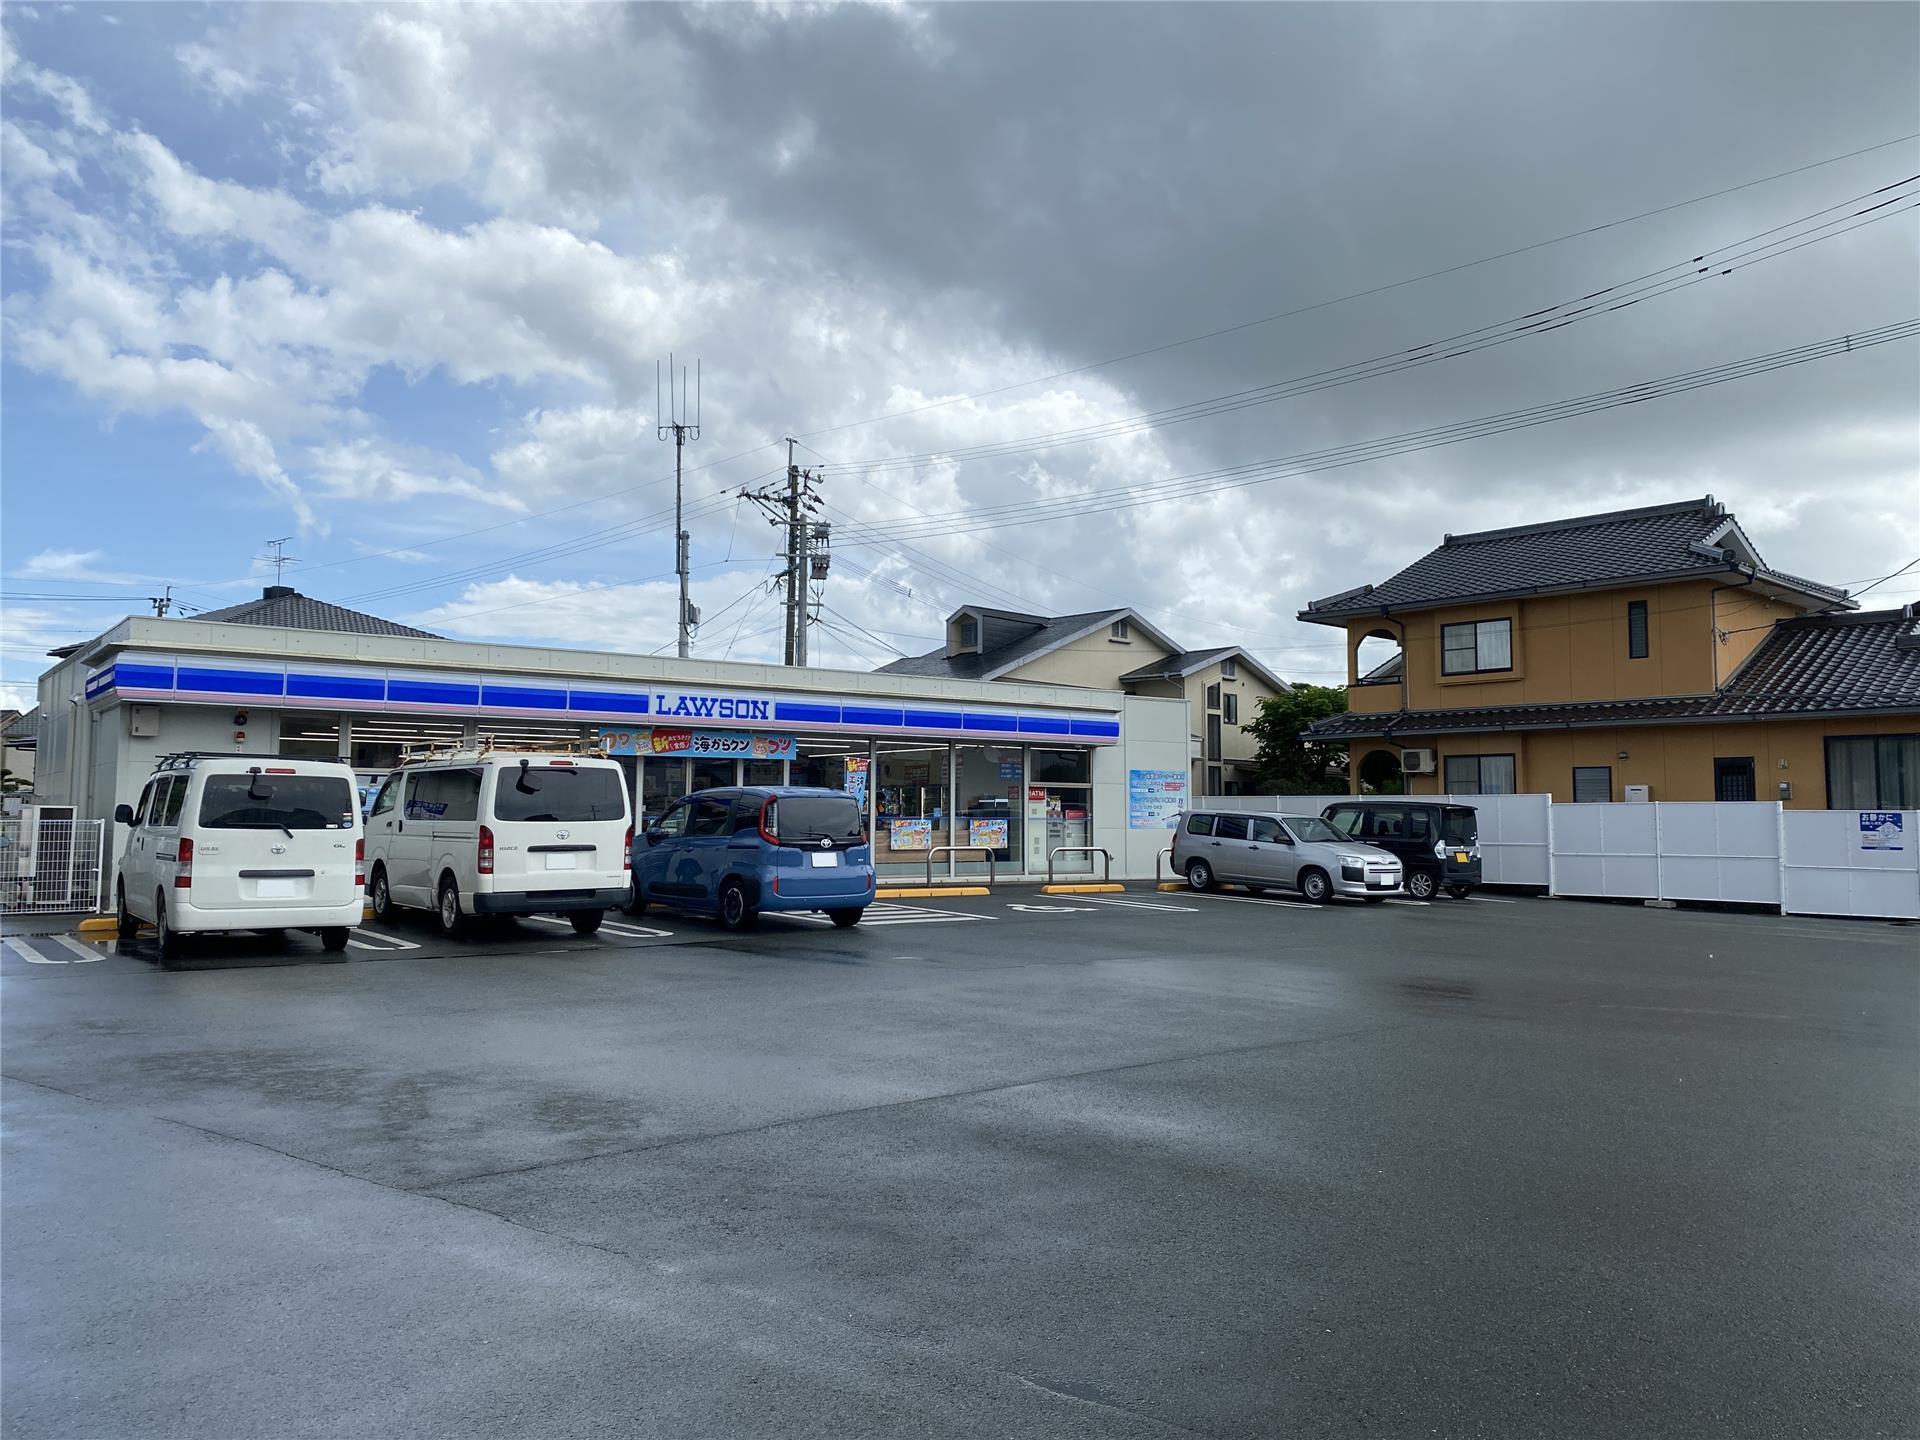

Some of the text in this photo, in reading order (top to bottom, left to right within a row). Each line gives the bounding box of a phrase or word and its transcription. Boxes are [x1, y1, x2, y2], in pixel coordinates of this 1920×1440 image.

[656, 695, 769, 720] LAWSON
[653, 735, 669, 752] 新
[693, 735, 750, 753] 海からクン
